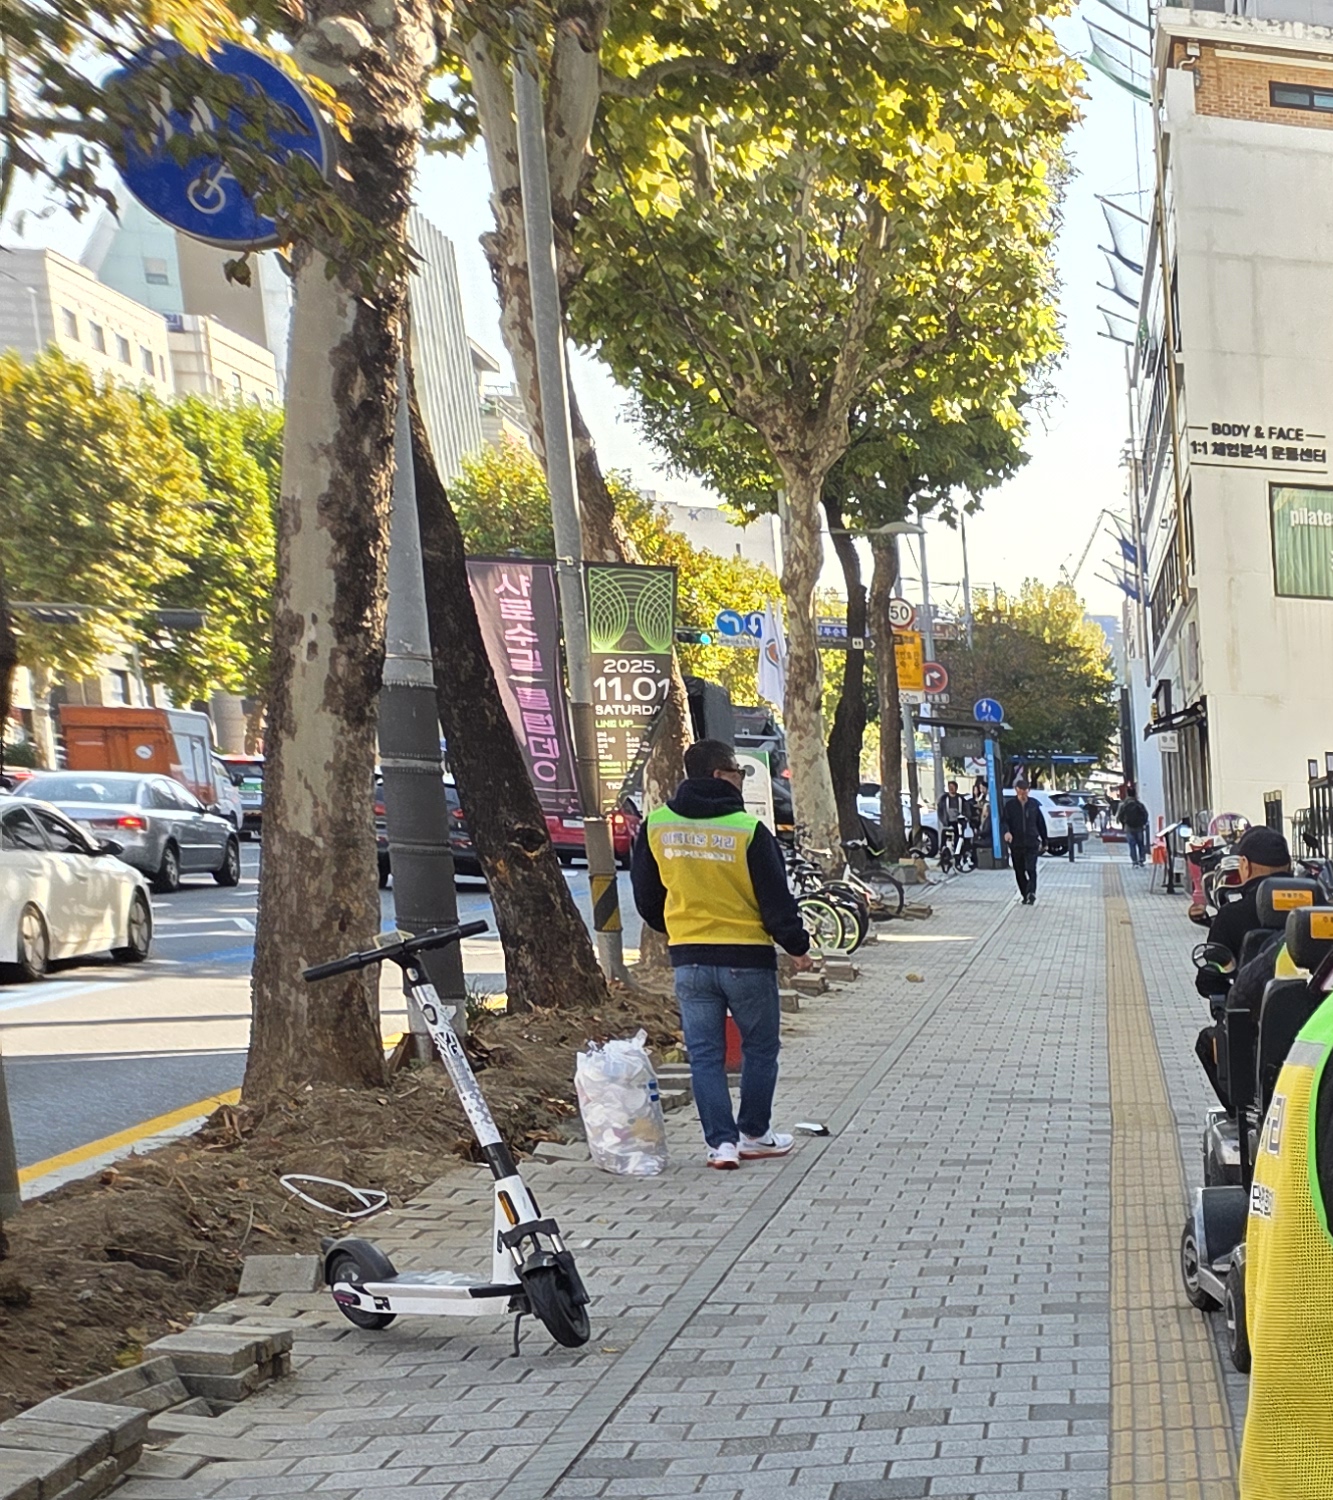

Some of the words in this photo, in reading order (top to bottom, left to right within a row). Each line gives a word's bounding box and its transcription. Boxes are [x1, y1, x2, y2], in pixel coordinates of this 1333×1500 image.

[1211, 422, 1250, 438] BODY
[1254, 425, 1265, 439] &
[1268, 426, 1304, 441] FACE
[889, 605, 910, 621] 50
[603, 659, 661, 674] 2025.
[593, 676, 671, 701] 11.01
